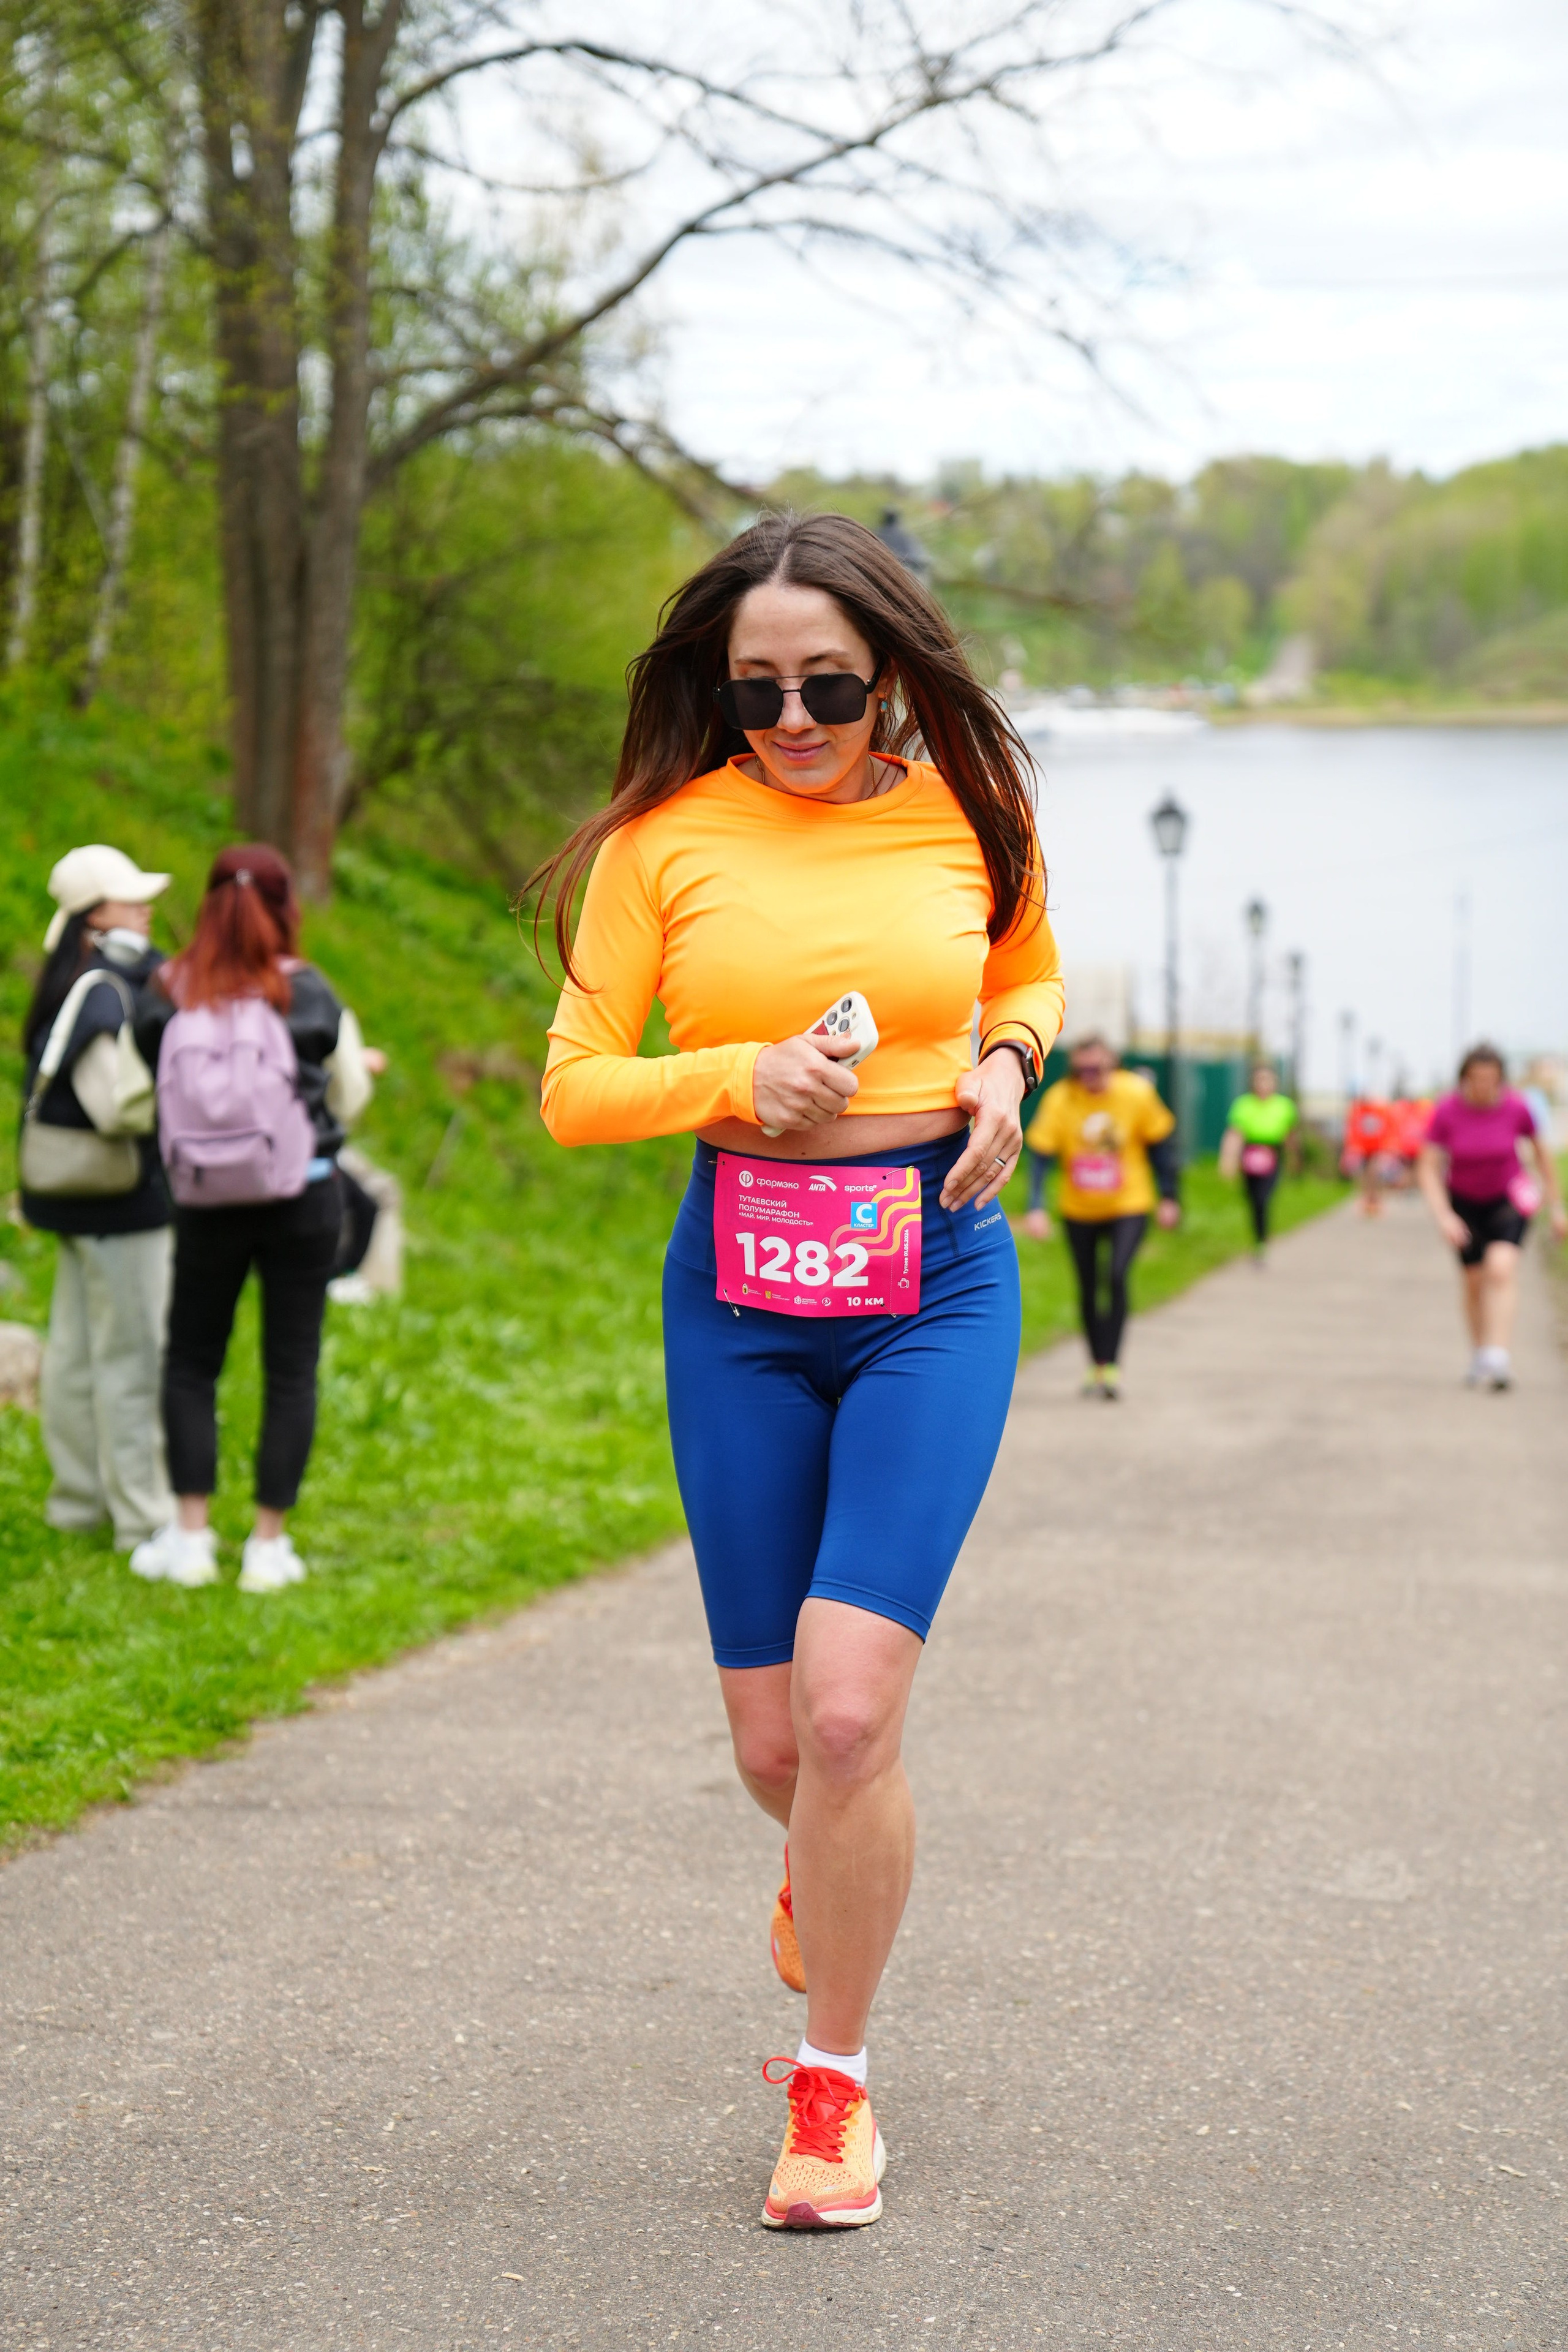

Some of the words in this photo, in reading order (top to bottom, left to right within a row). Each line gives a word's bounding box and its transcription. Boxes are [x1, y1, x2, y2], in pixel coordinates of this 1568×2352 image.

[756, 1177, 799, 1189] фармэко
[739, 1194, 787, 1208] ТУТАЕВСКИЙ
[739, 1204, 799, 1218] ПОЛУМАРАФОН
[772, 1216, 813, 1226] МОЛОДОСТЬ»
[974, 1212, 1002, 1231] KICKERS
[736, 1232, 869, 1287] 1282
[846, 1296, 861, 1306] 10
